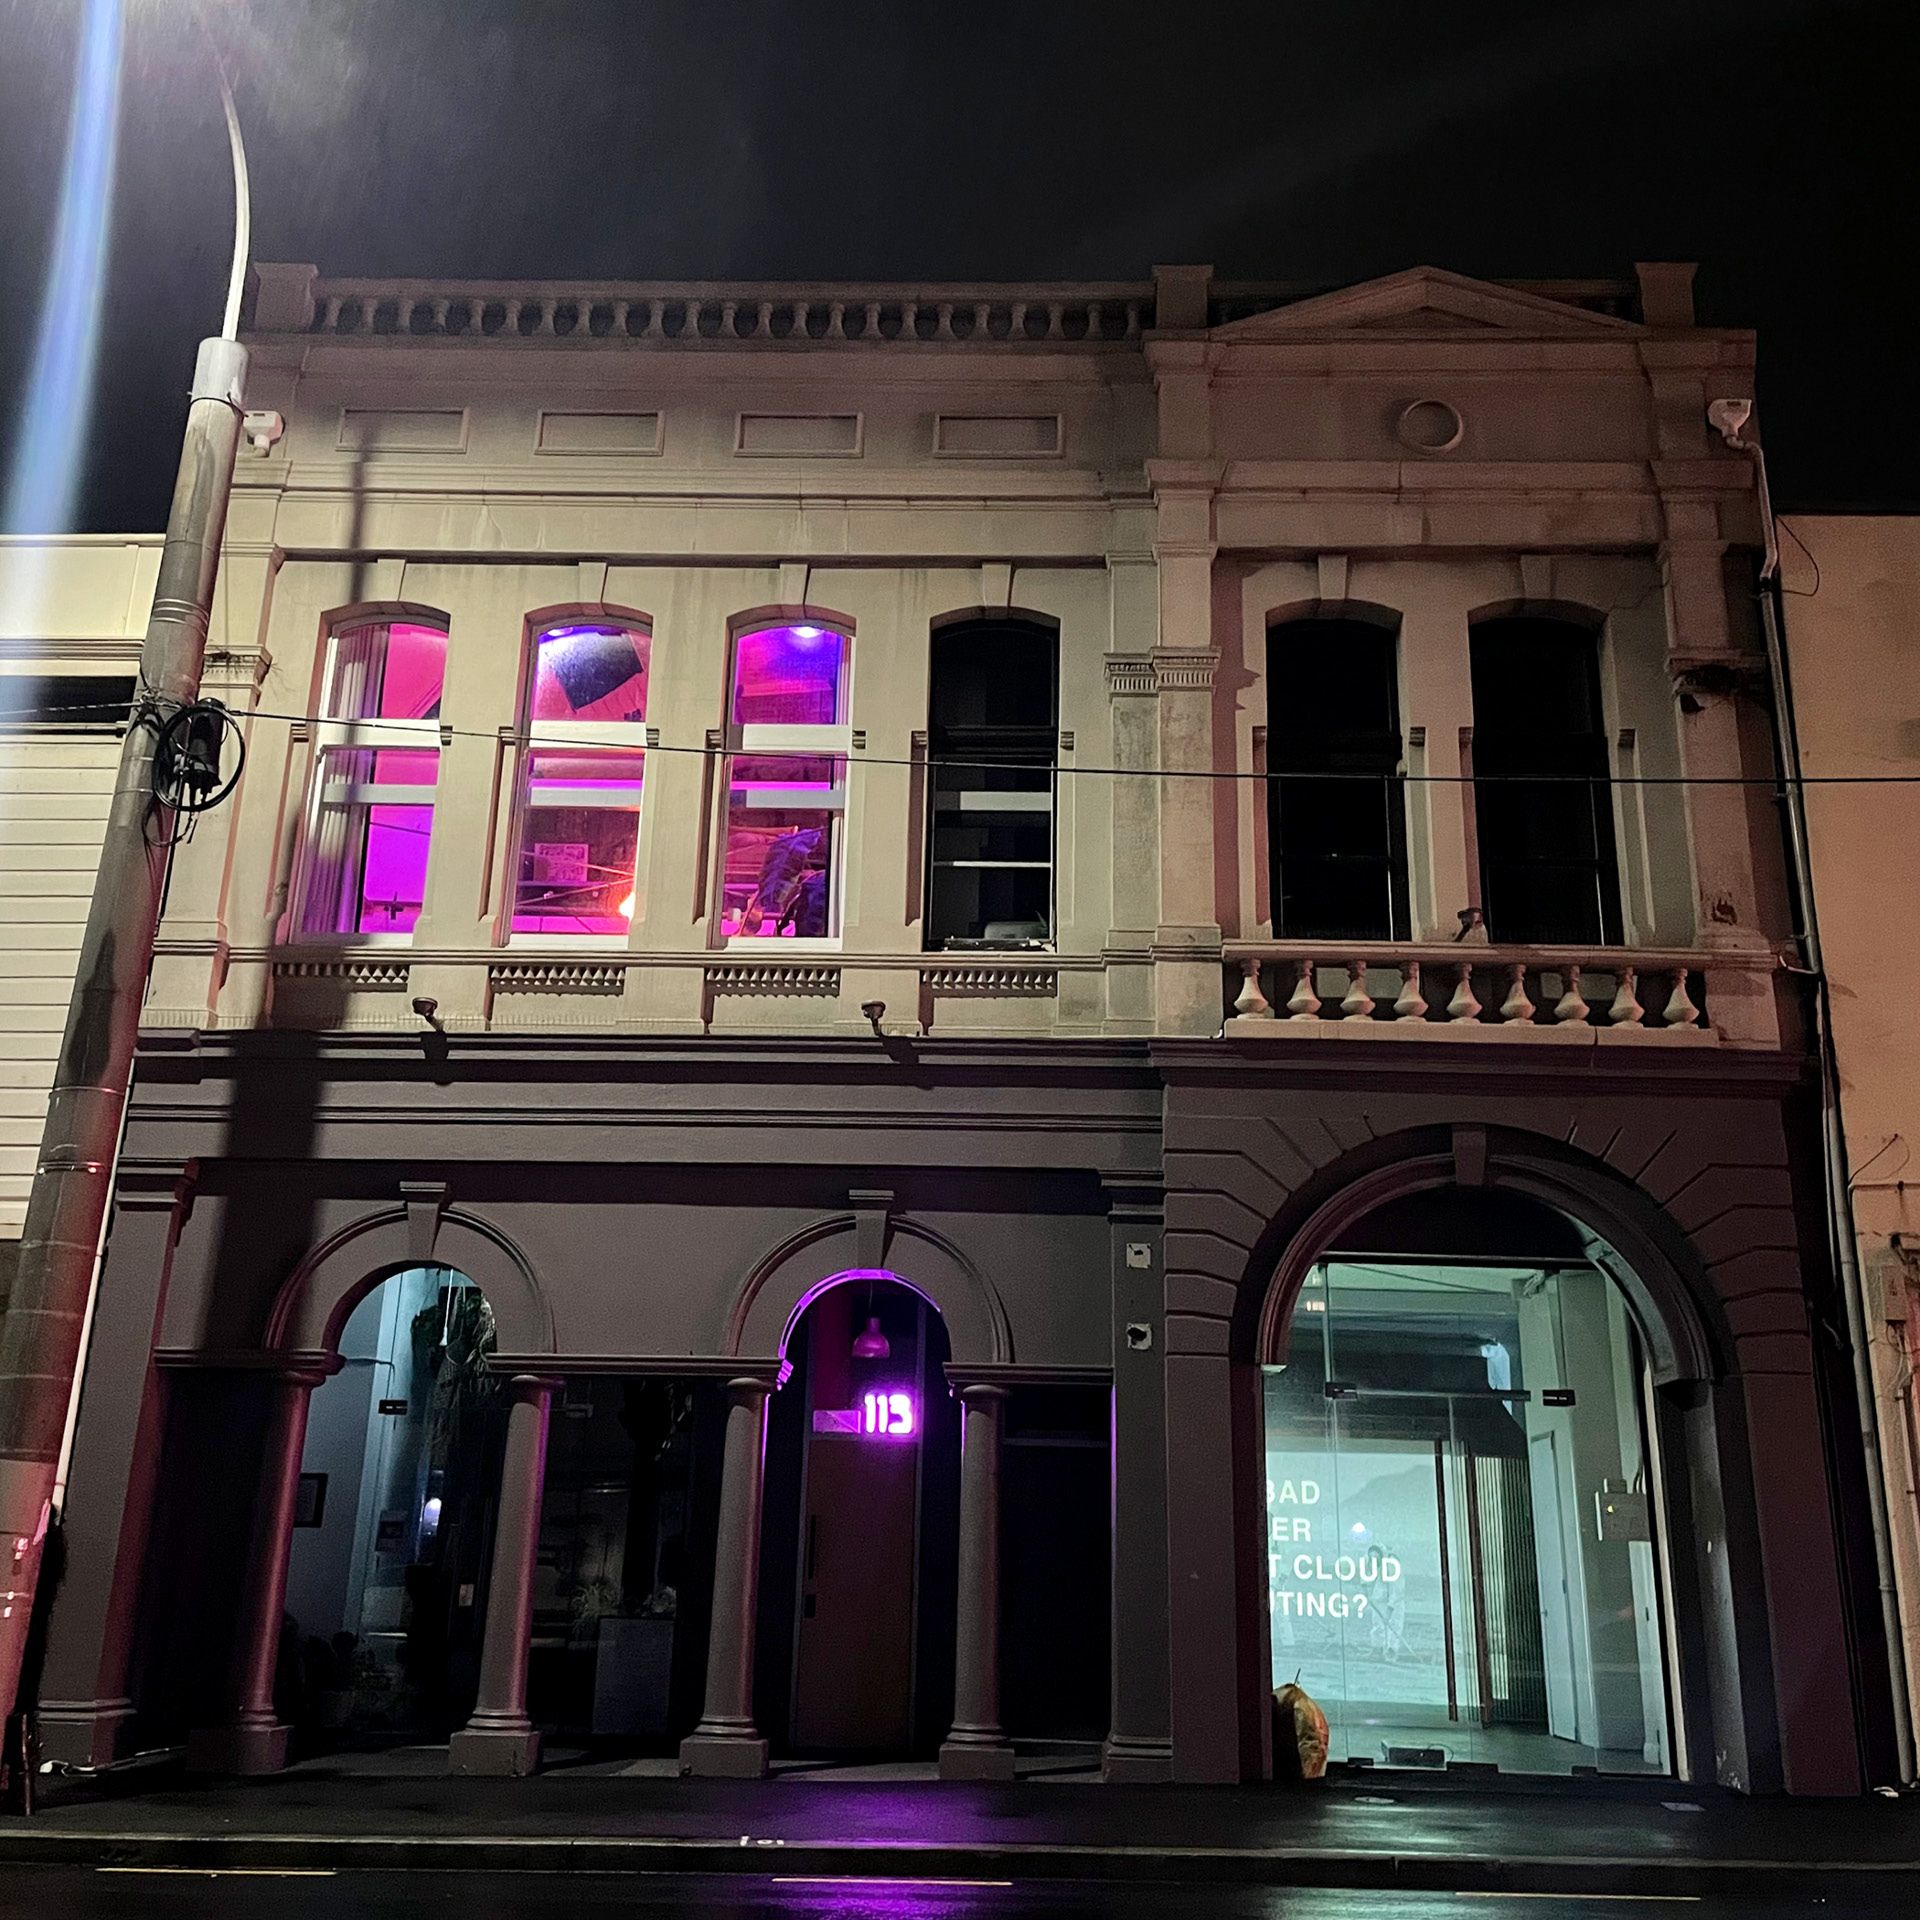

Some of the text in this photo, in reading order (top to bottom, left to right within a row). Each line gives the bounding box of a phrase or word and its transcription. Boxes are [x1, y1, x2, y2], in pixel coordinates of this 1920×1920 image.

[864, 1393, 913, 1434] 113
[1272, 1517, 1312, 1542] ER
[1293, 1554, 1401, 1582] CLOUD
[1270, 1591, 1368, 1618] TING?
